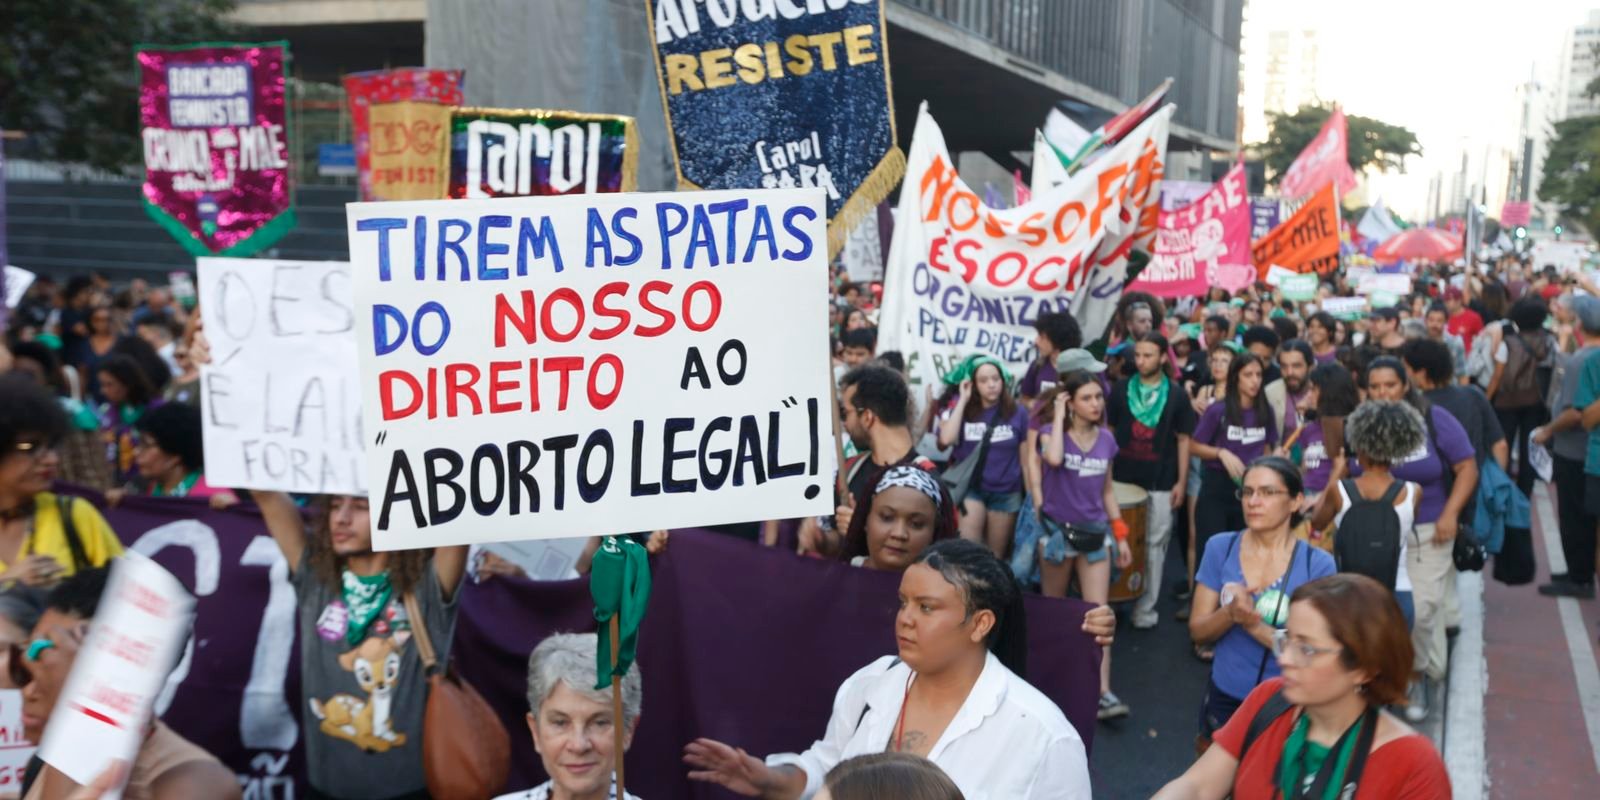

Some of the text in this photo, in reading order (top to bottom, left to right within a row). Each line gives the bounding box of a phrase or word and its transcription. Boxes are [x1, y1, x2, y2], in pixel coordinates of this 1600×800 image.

[665, 24, 878, 95] RESISTE
[467, 119, 601, 199] Carol
[755, 131, 821, 173] Carol
[358, 216, 563, 280] TIREM
[586, 208, 642, 267] AS
[656, 199, 816, 269] PATAS
[373, 280, 722, 355] DO NOSSO
[919, 307, 968, 346] PEO
[376, 339, 747, 420] DIREITO AO
[376, 396, 820, 530] "ABORTO LEGAL"!
